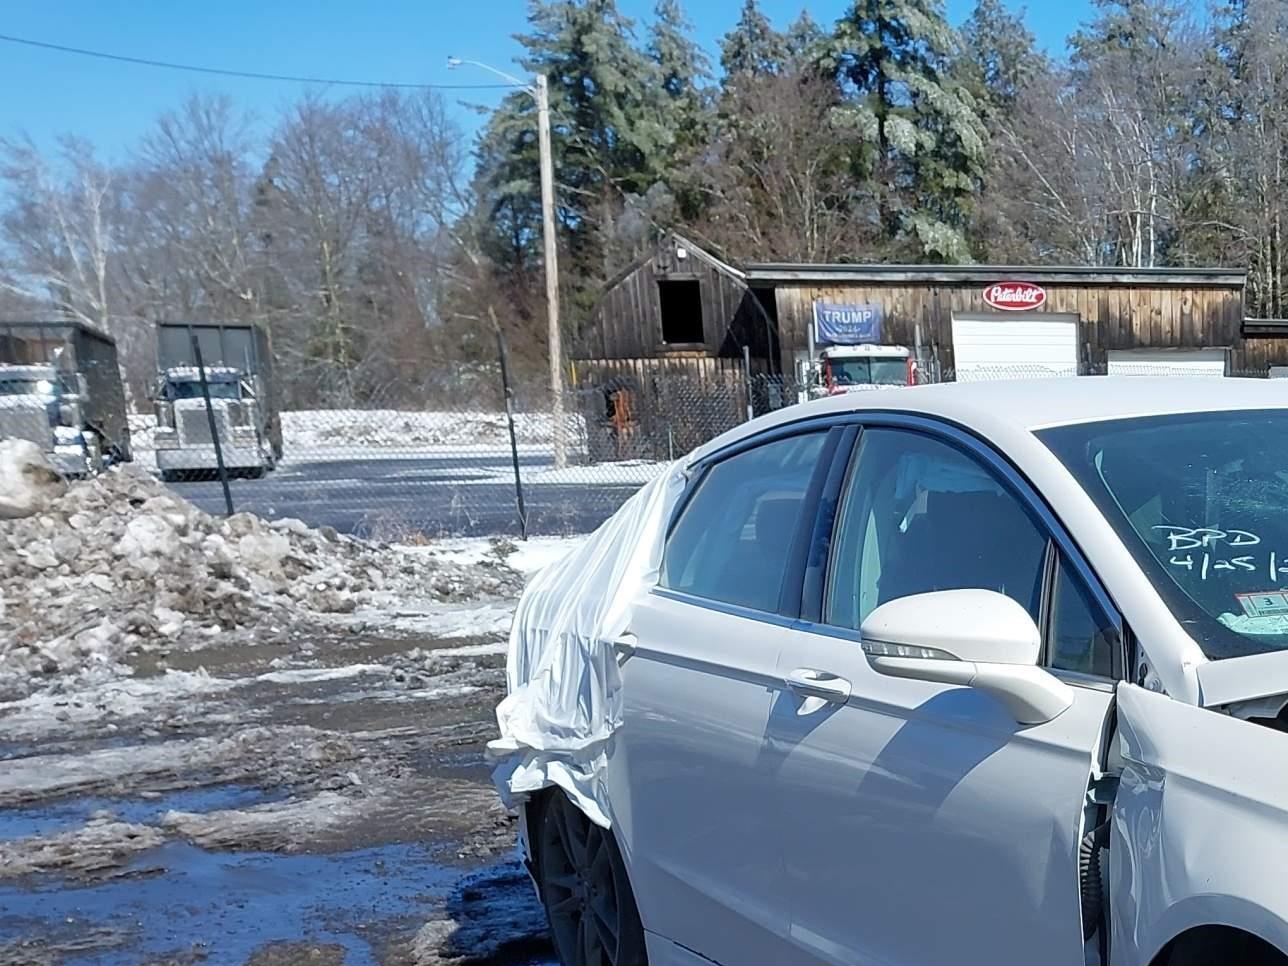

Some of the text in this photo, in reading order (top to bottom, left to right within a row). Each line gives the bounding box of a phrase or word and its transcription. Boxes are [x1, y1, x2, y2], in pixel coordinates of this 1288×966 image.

[990, 286, 1042, 302] Peterbilt
[823, 310, 872, 324] TRUMP
[1151, 525, 1261, 551] BPD
[1263, 597, 1273, 606] 3
